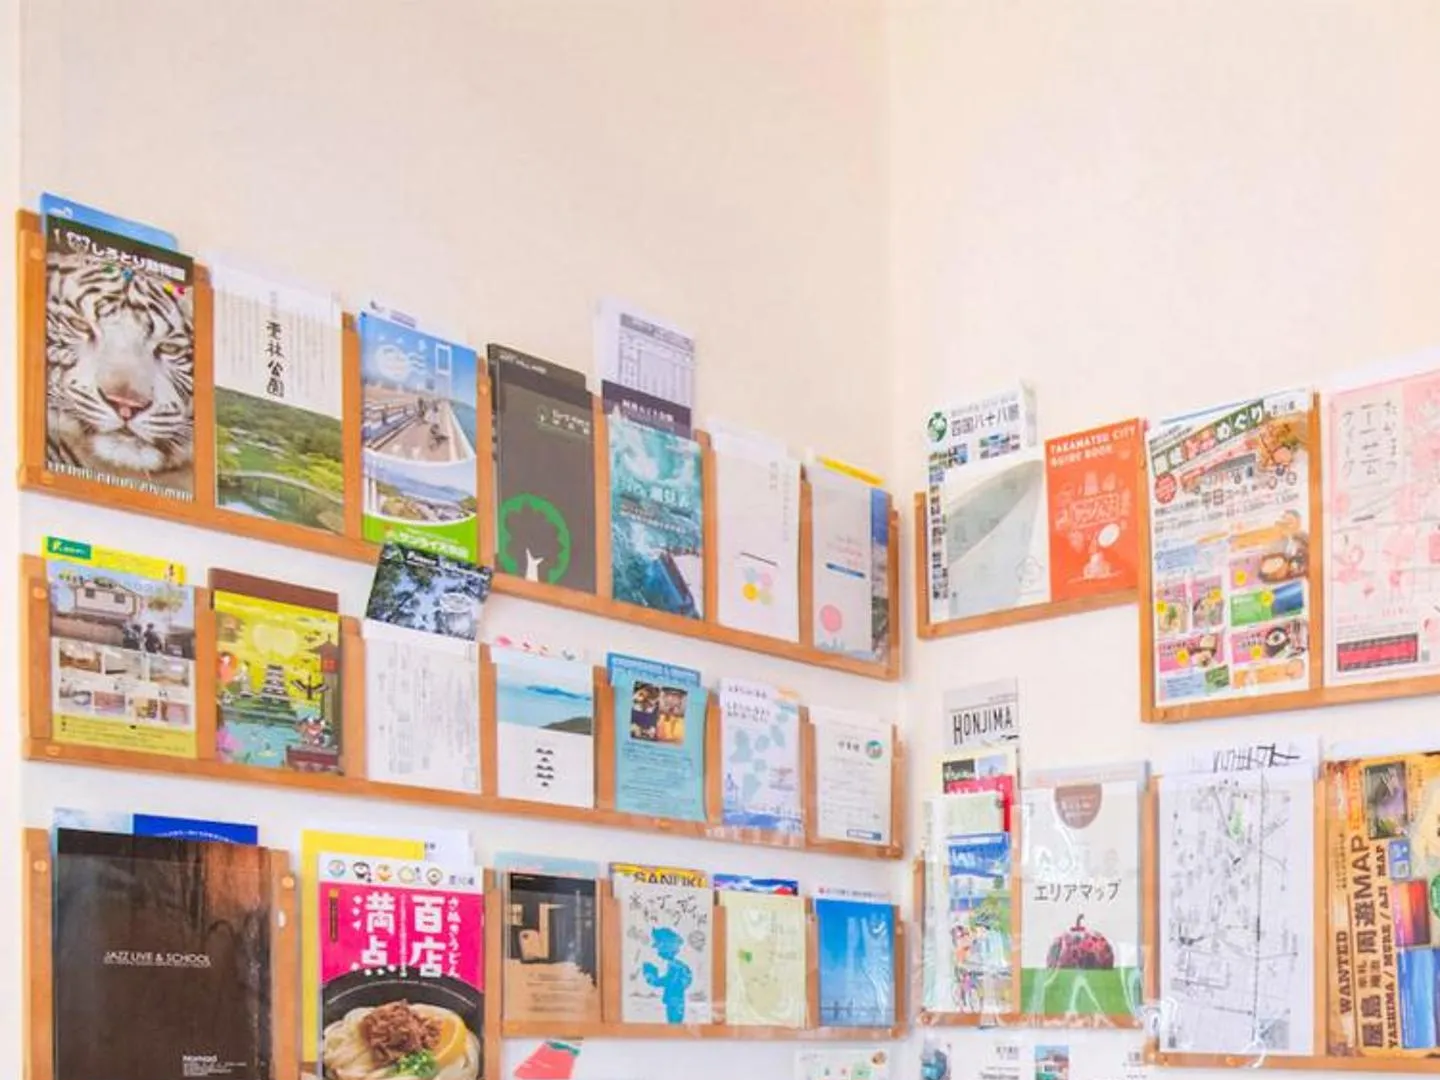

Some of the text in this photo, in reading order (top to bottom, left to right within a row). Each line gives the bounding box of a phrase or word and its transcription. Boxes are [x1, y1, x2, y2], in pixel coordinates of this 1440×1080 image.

[1050, 433, 1110, 455] TAKAMATSU
[1112, 425, 1137, 442] CITY
[952, 706, 1013, 745] HONJIMA
[1376, 844, 1387, 877] MAP
[1034, 879, 1122, 901] エリアマップ
[409, 894, 447, 978] 百店
[1335, 931, 1353, 1014] WANTED
[1384, 982, 1398, 1048] YASHIMA
